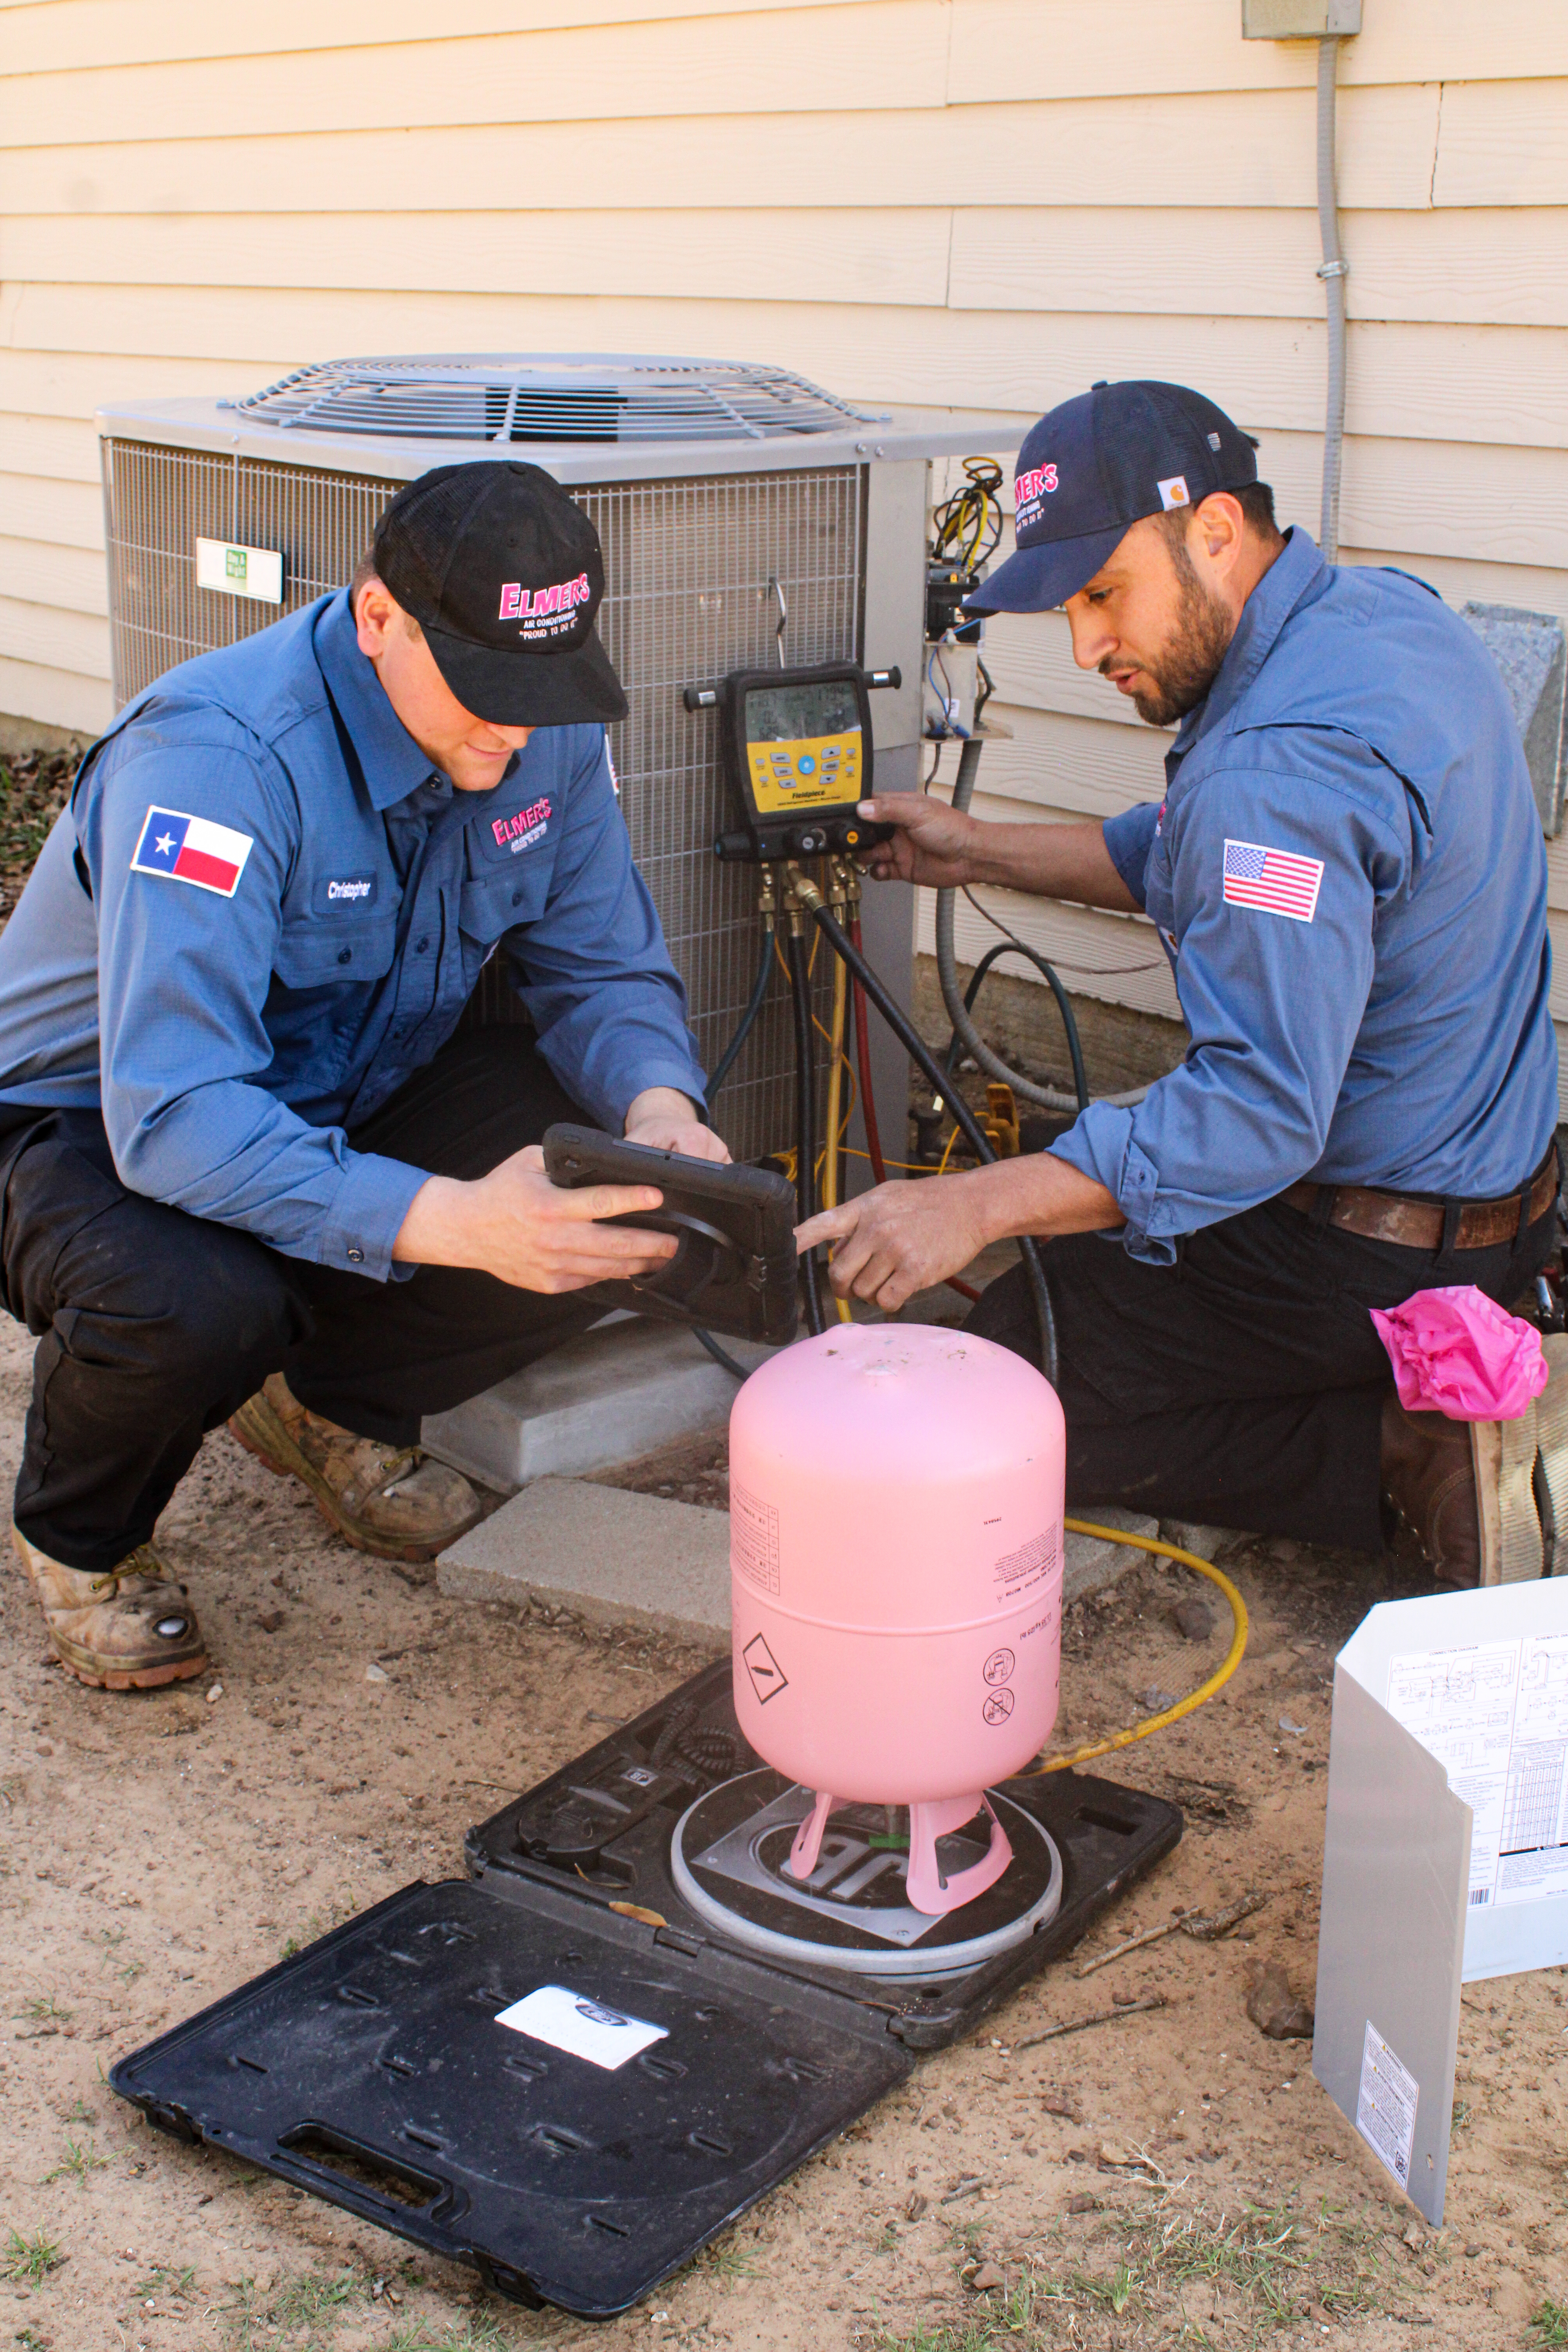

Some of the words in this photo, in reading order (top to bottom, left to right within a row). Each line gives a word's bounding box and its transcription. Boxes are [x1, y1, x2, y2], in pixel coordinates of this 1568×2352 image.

[523, 619, 535, 629] AIR
[536, 609, 576, 628] CONDITIONING
[550, 626, 558, 636] TO
[560, 622, 568, 633] DO
[328, 880, 371, 901] Christopher
